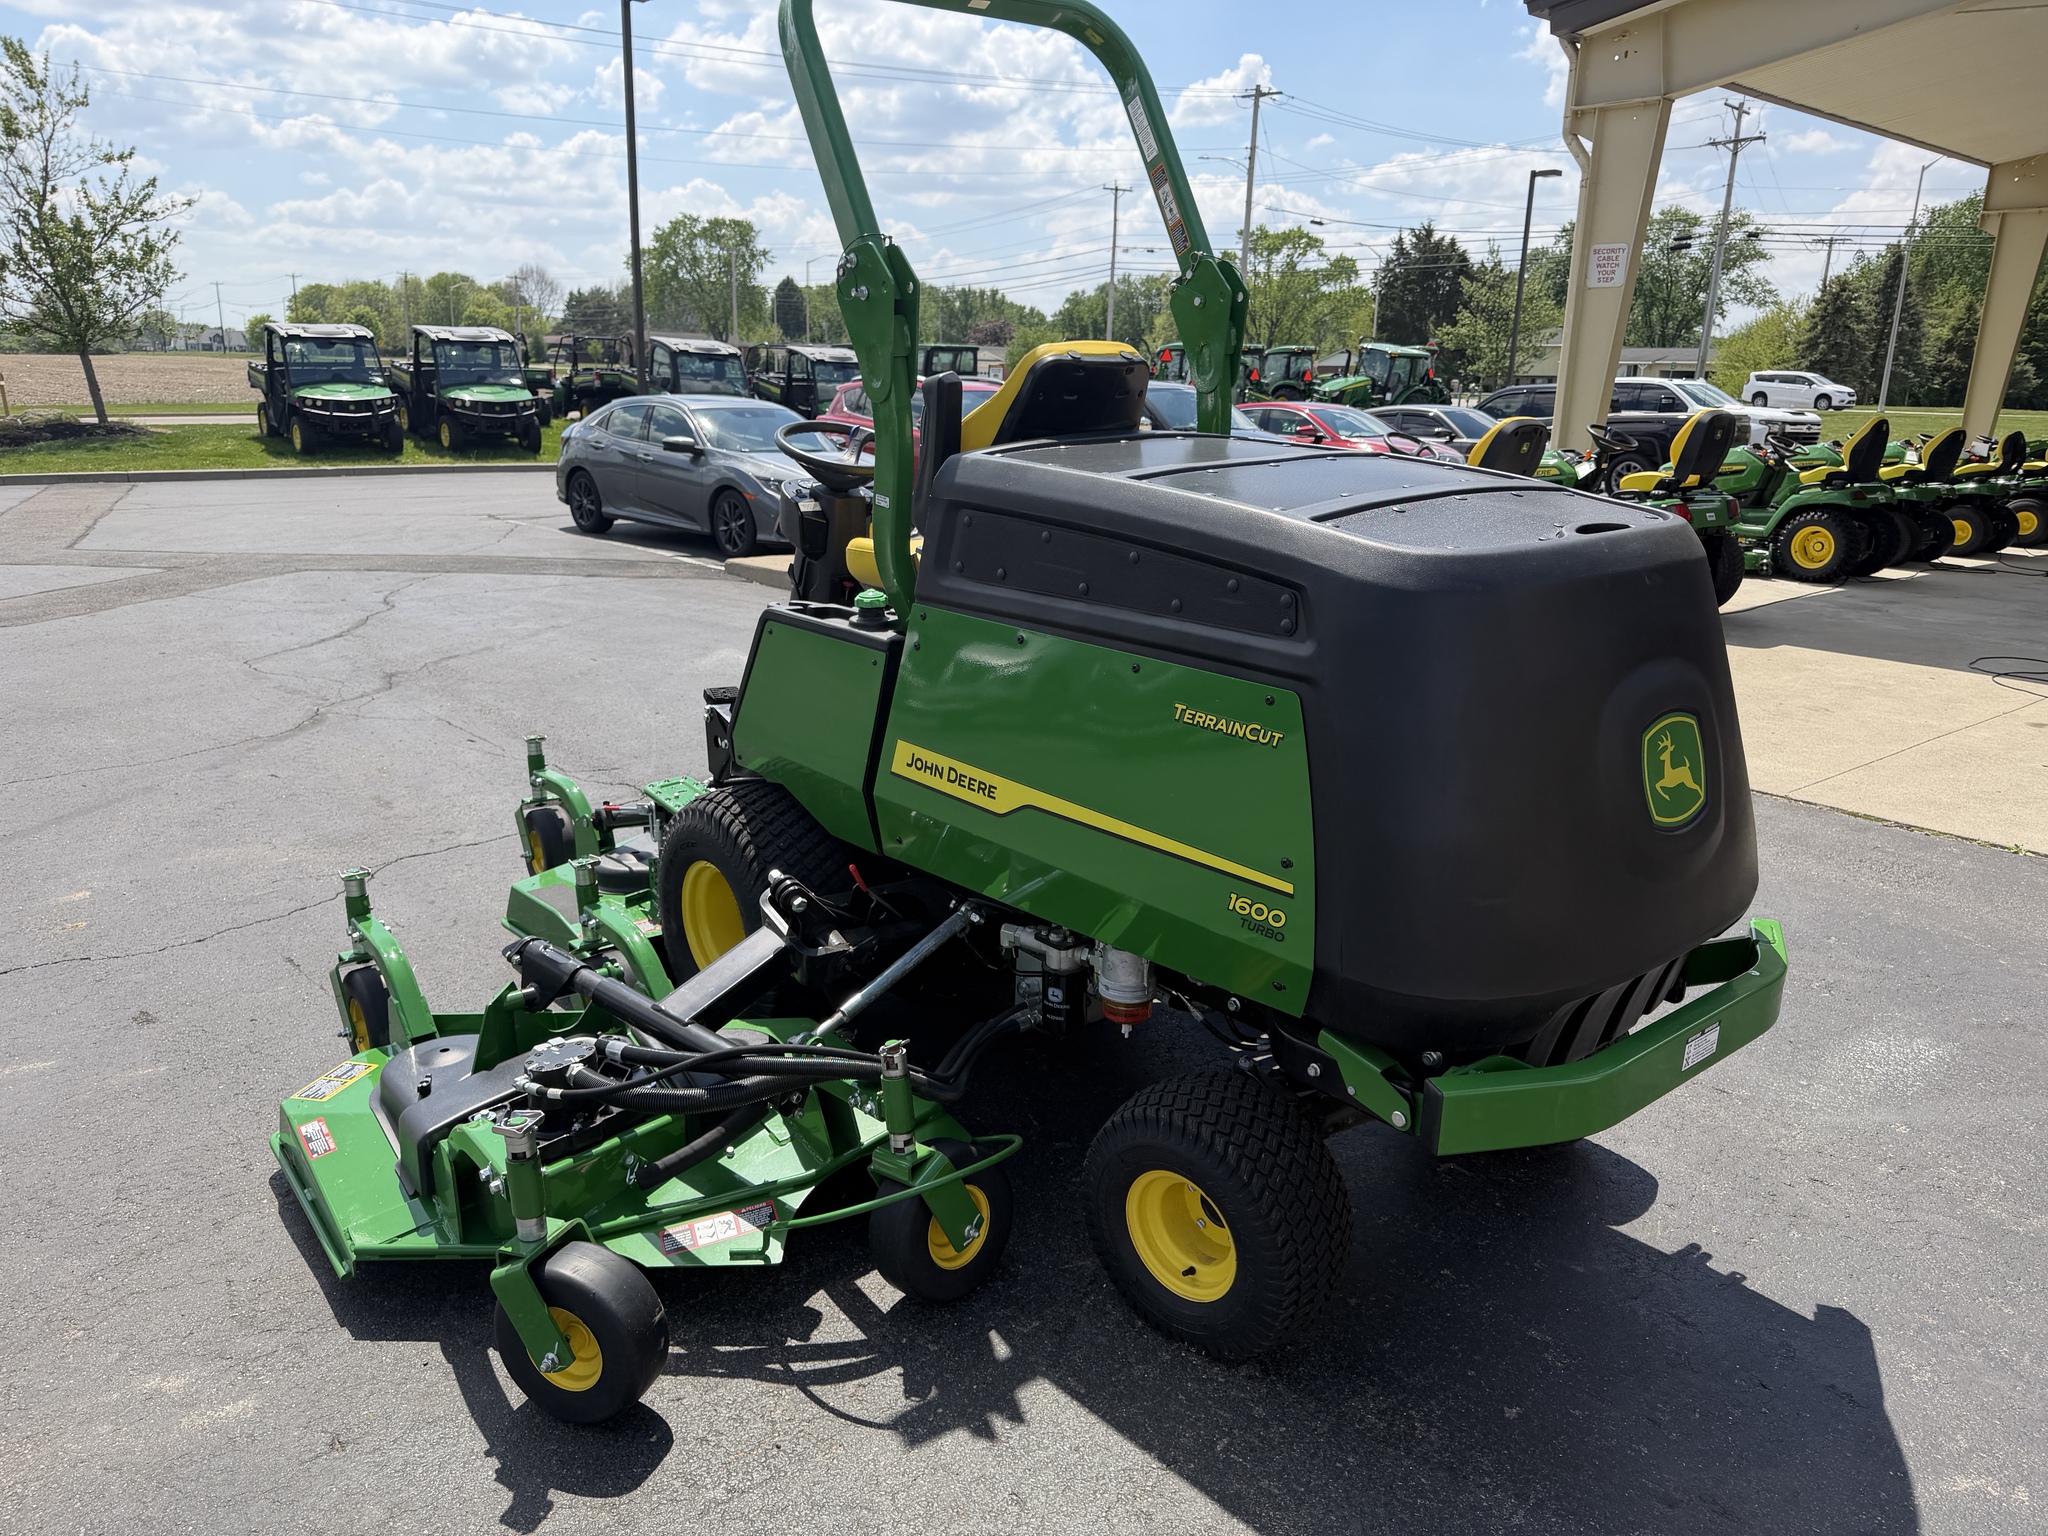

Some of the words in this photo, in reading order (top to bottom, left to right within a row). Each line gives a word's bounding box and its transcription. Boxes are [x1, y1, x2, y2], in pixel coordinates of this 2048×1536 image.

[1174, 702, 1285, 749] TERRAINCUT
[906, 752, 945, 780] JOHN
[946, 766, 998, 800] DEERE
[1227, 891, 1287, 929] 1600
[1240, 917, 1285, 942] TURBO
